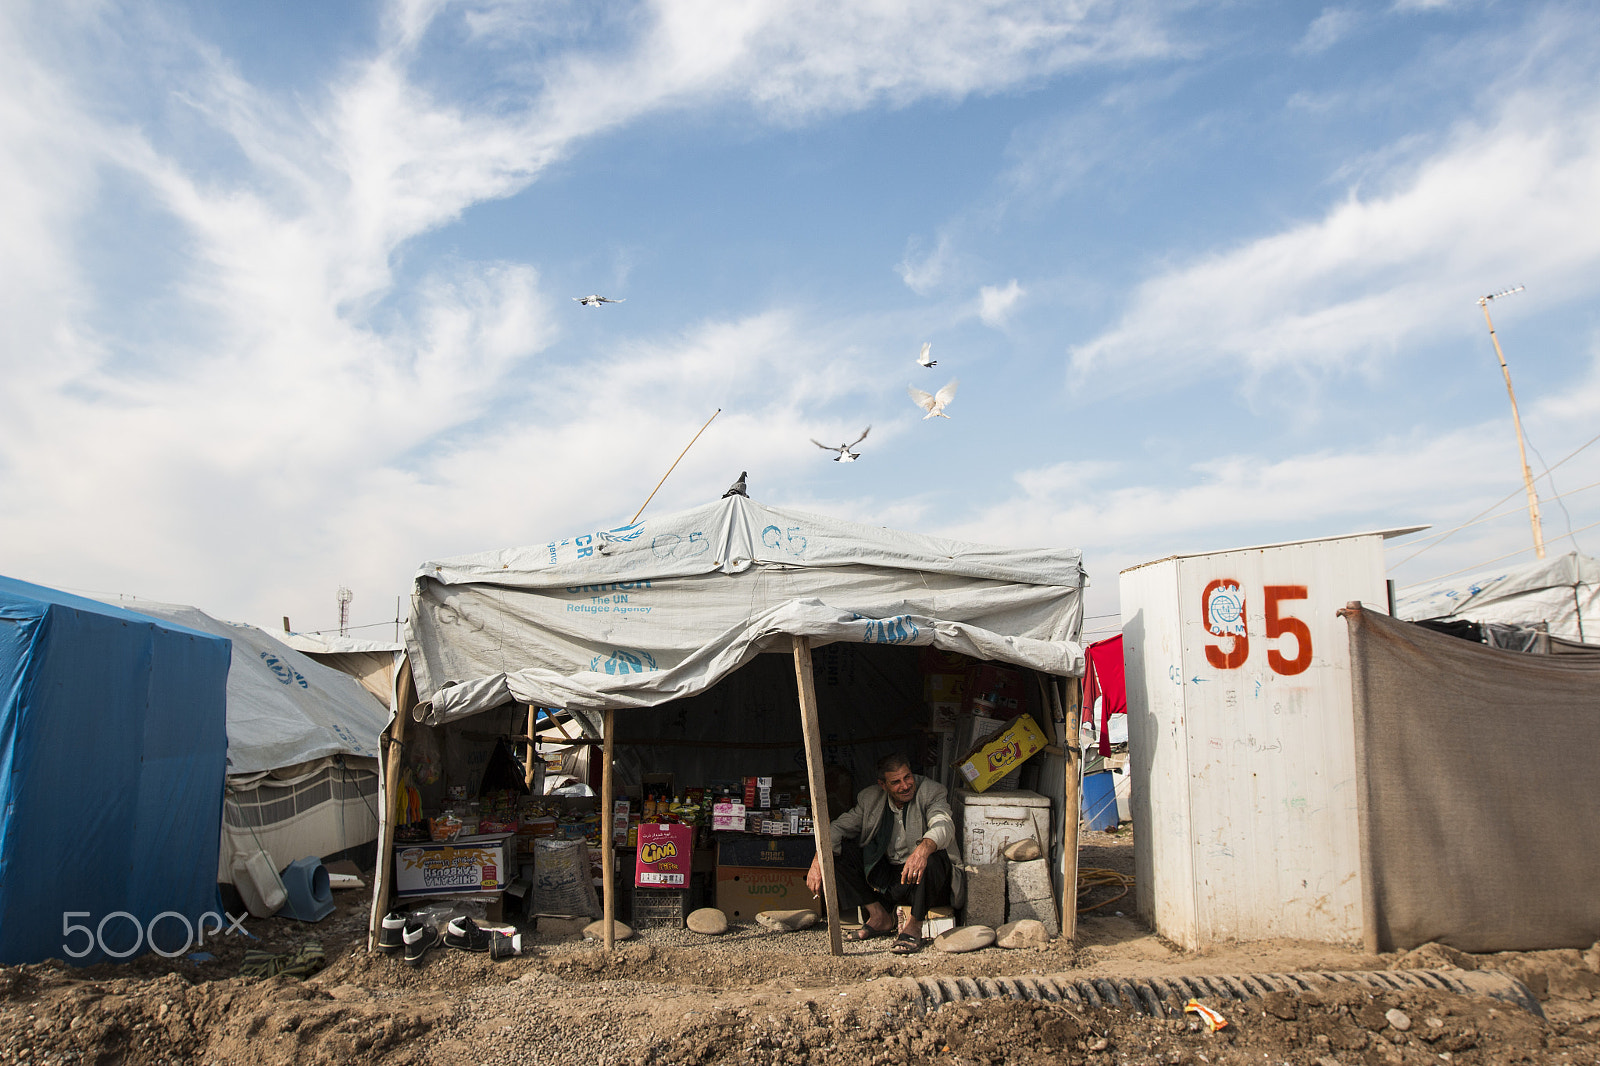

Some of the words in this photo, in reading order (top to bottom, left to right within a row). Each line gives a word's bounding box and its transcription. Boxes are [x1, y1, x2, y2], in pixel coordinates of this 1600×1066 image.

[590, 596, 610, 605] The
[613, 594, 629, 604] UN
[566, 604, 610, 615] Refugee
[613, 605, 652, 615] Agency
[1201, 578, 1313, 676] 95
[423, 866, 478, 878] TARBOUSH
[423, 875, 478, 887] CHIPSANA
